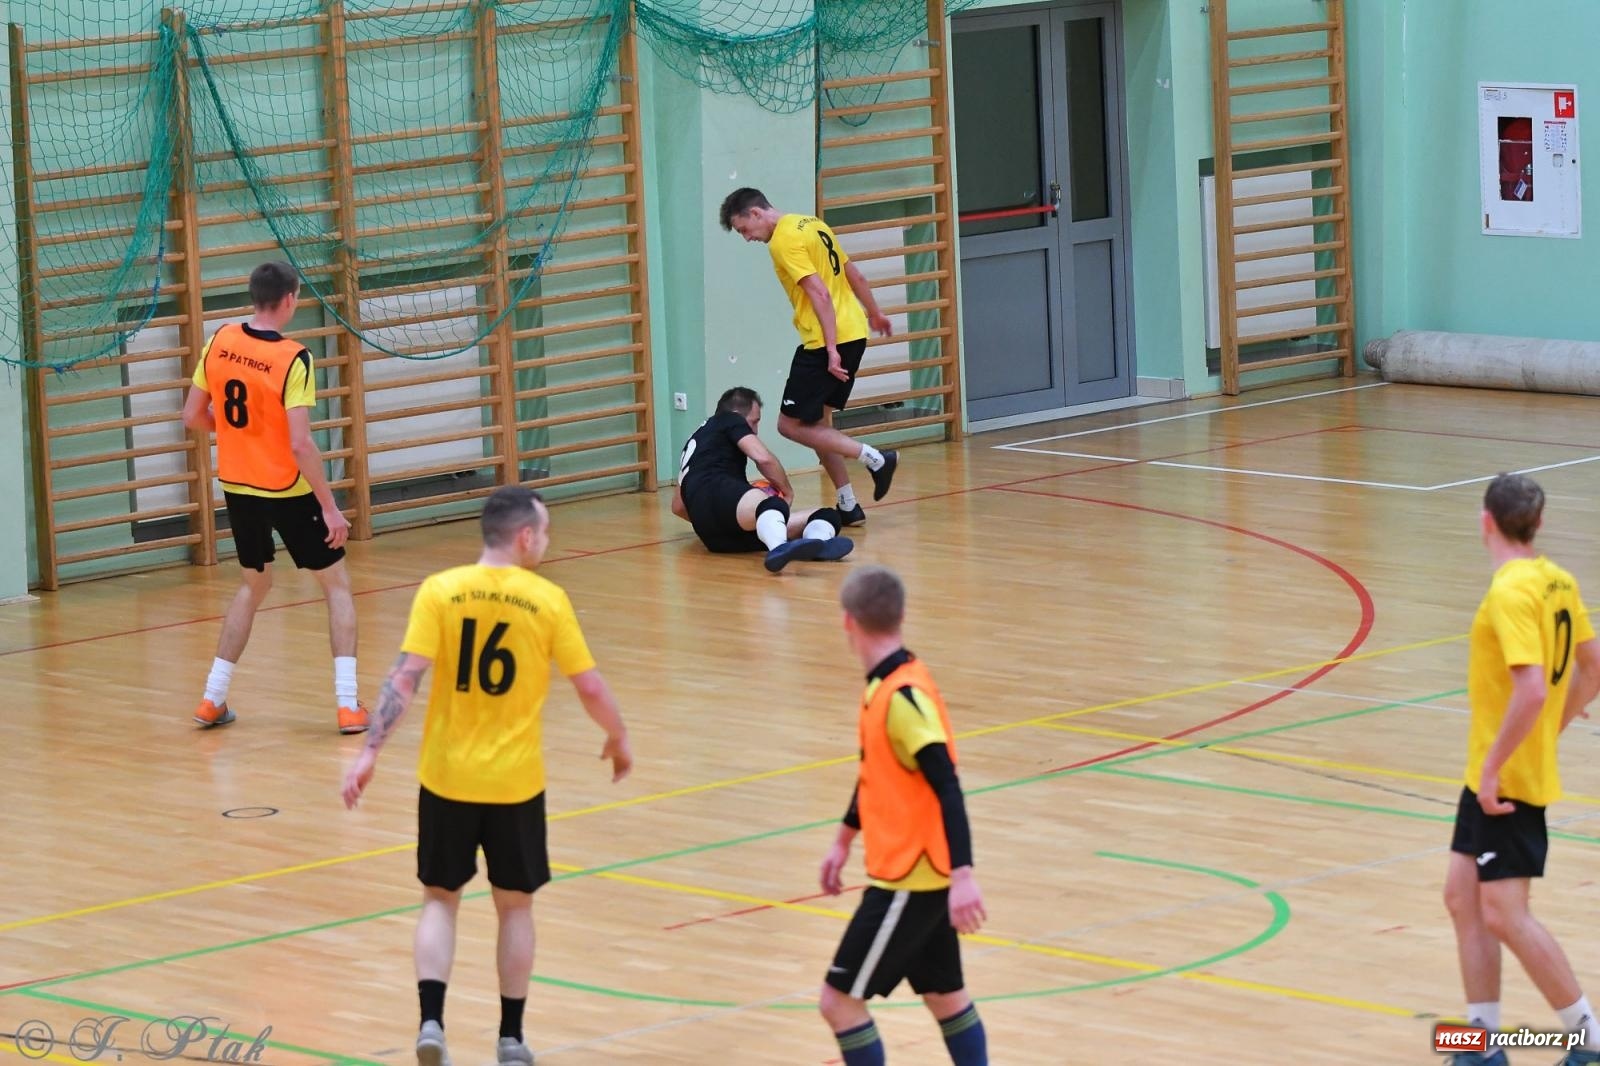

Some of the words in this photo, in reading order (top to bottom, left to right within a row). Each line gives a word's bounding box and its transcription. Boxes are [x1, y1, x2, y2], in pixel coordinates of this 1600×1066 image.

[816, 230, 841, 276] 8
[229, 353, 273, 375] PATRICK
[224, 378, 249, 429] 8
[455, 617, 517, 697] 16
